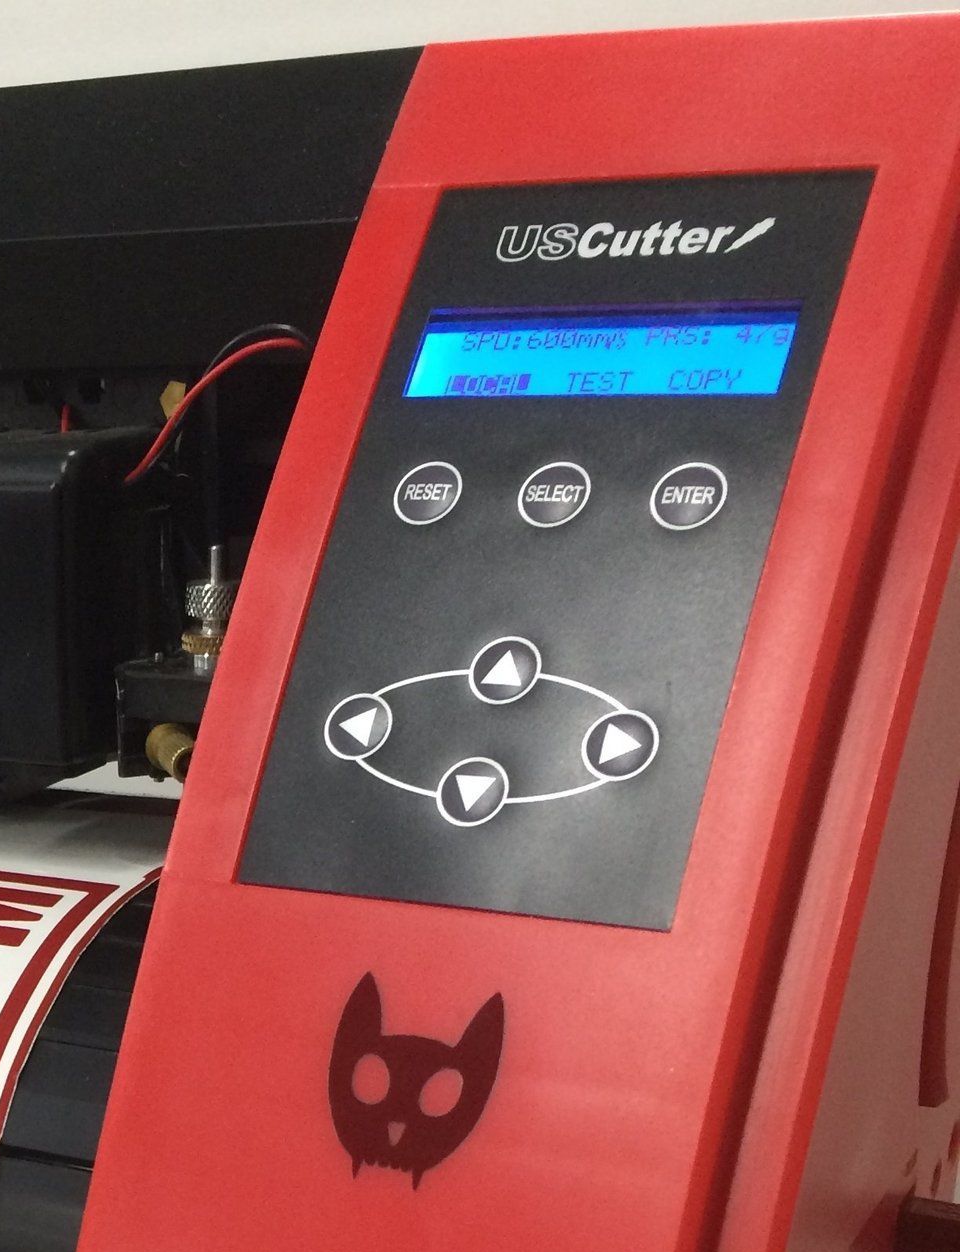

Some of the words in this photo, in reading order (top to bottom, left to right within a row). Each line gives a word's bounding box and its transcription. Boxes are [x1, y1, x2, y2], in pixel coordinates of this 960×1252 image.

[496, 222, 734, 263] USCutter
[567, 370, 633, 393] TEST
[669, 368, 744, 391] COPY
[404, 483, 453, 502] RESET
[525, 484, 585, 504] SELECT
[661, 486, 716, 505] ENTER
